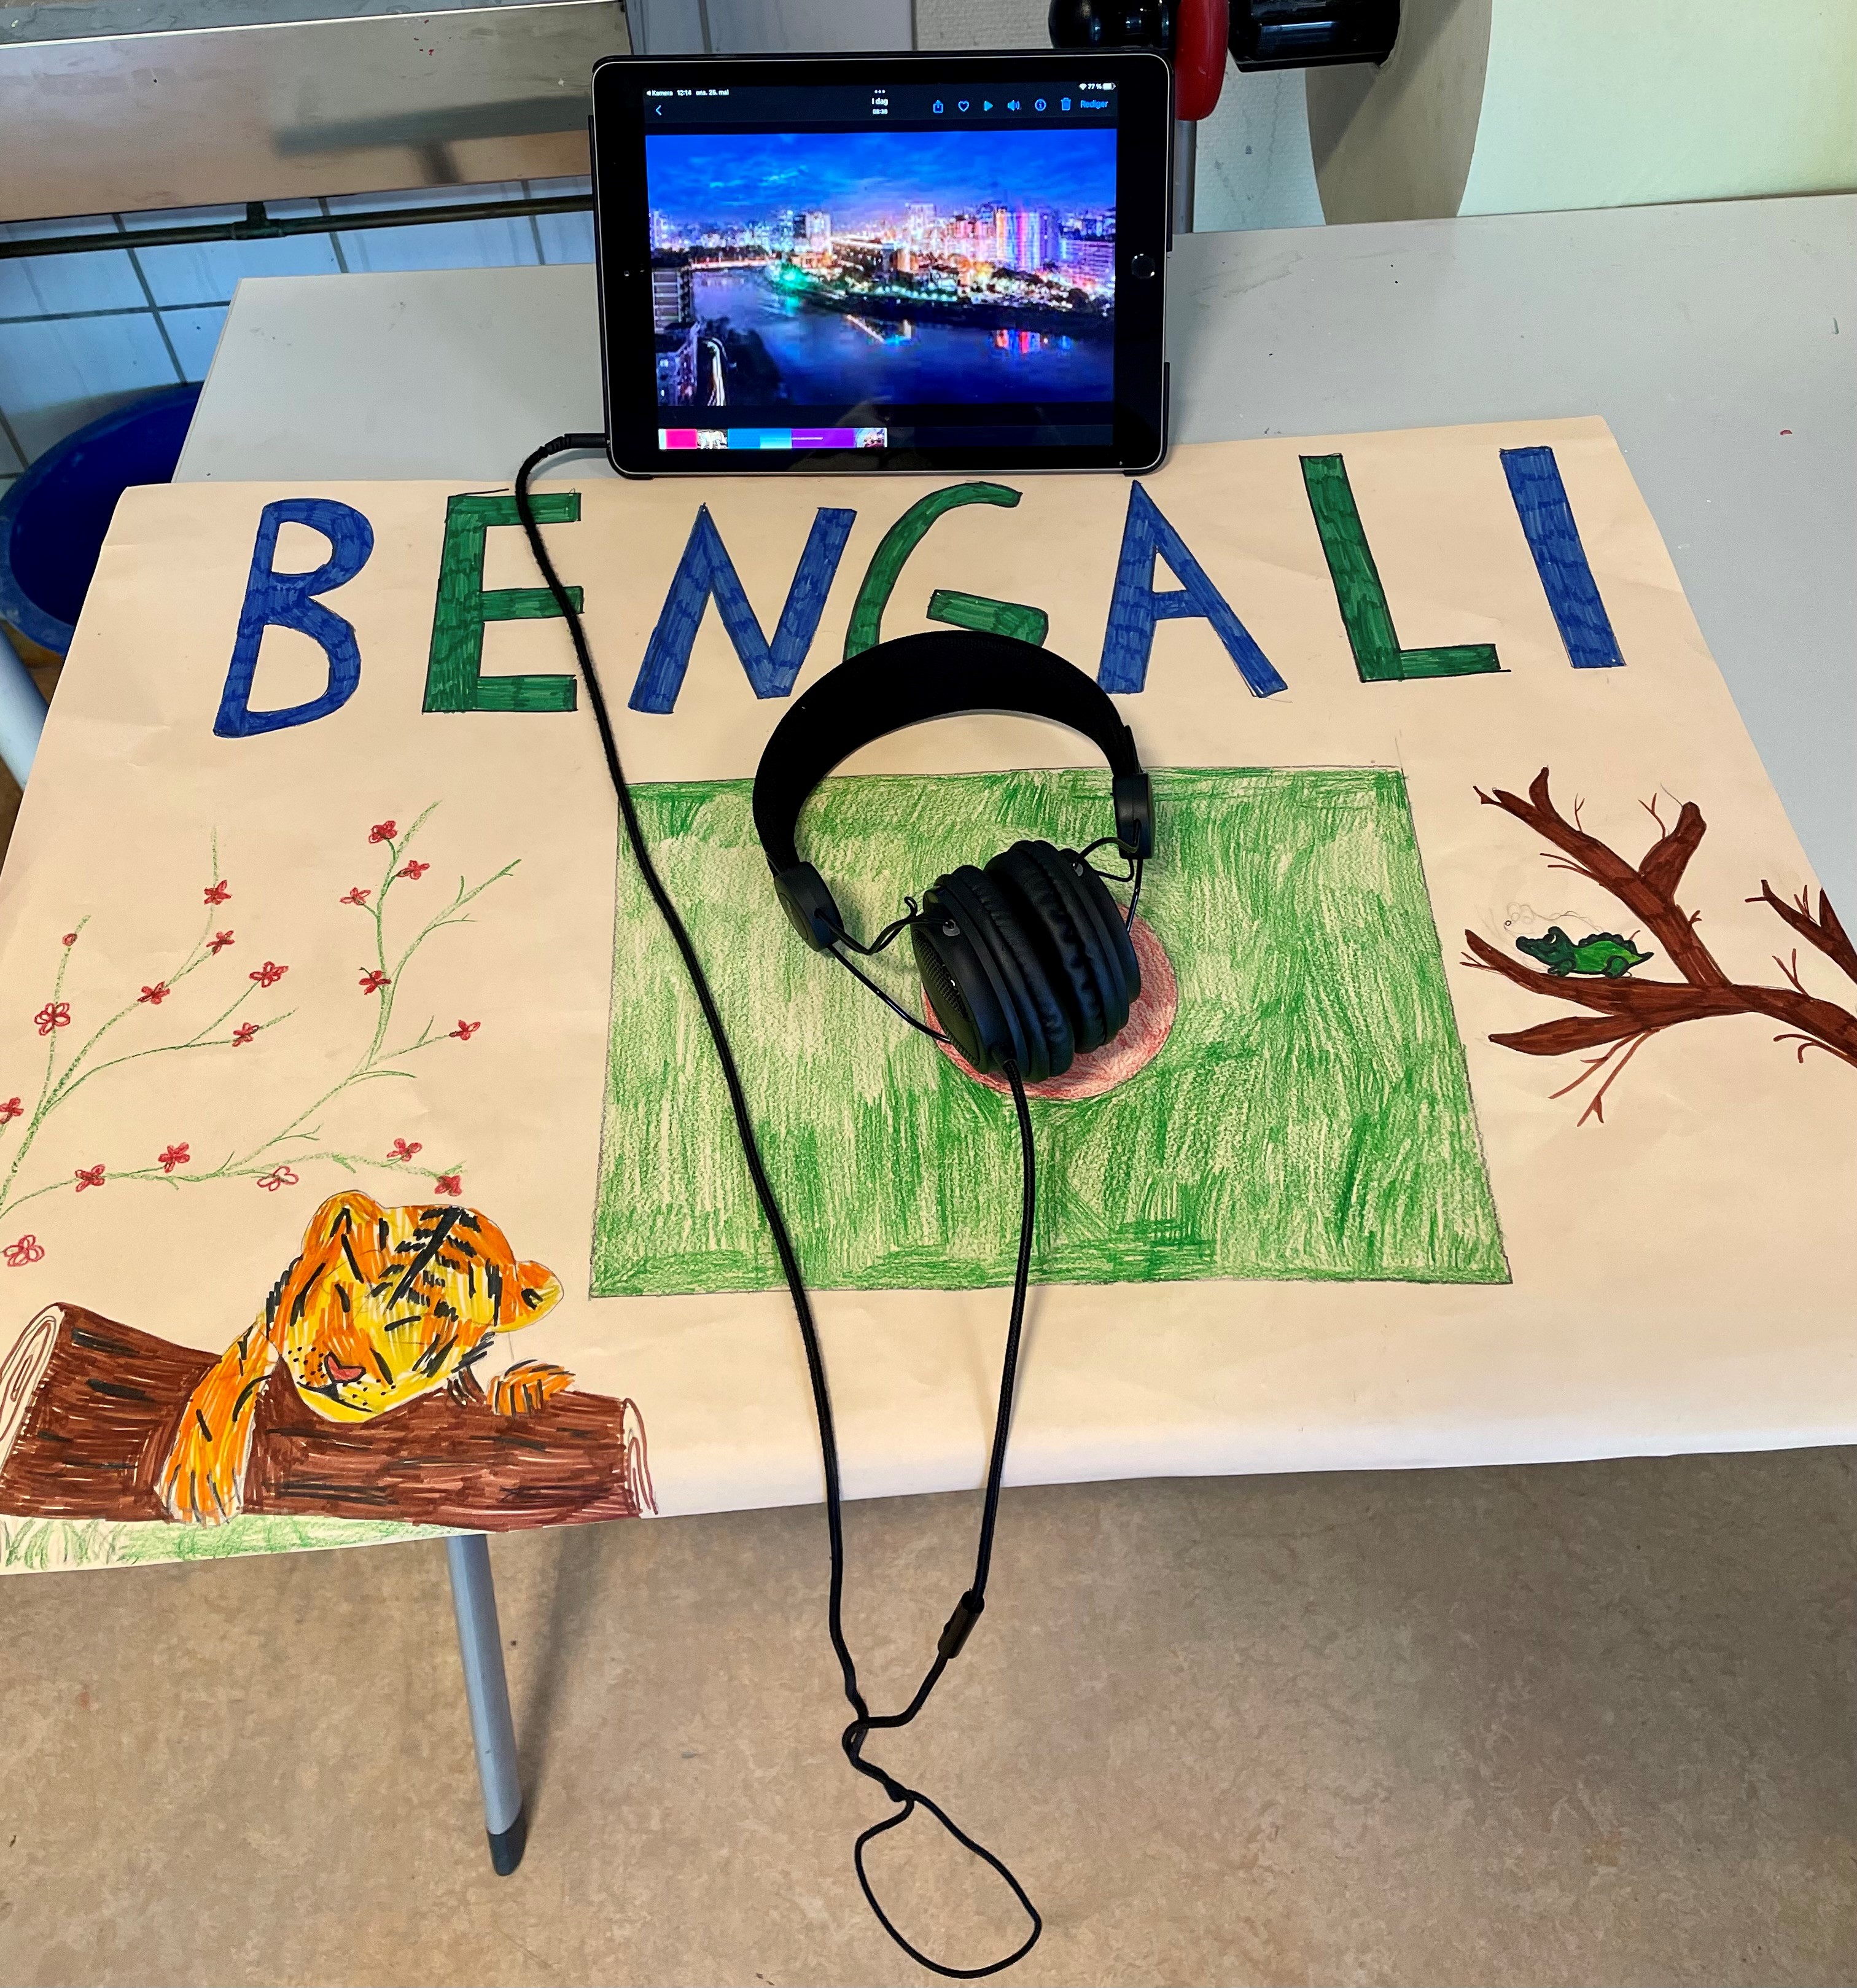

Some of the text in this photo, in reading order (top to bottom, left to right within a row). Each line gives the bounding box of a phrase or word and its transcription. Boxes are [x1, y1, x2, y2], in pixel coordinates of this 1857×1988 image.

[875, 97, 888, 106] dag
[1080, 99, 1108, 109] Rediger
[213, 446, 1626, 738] BENGALI
